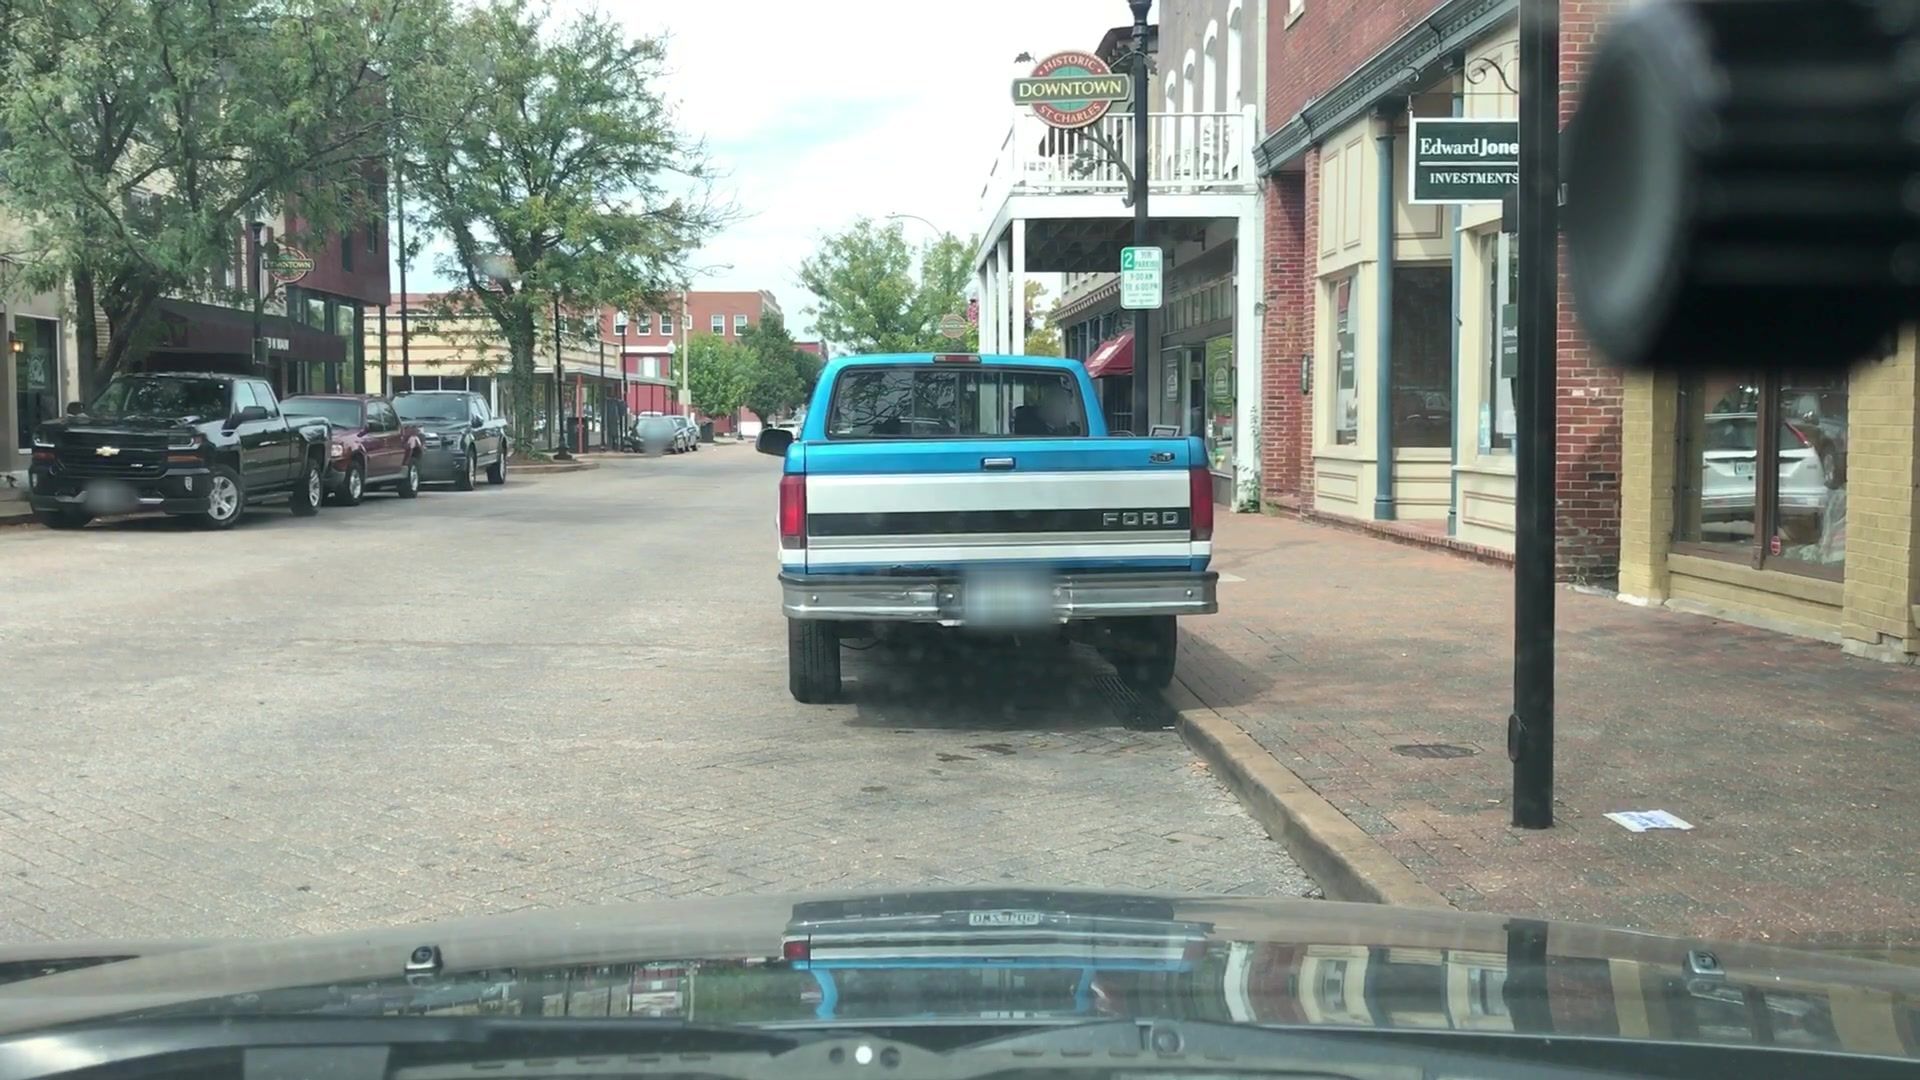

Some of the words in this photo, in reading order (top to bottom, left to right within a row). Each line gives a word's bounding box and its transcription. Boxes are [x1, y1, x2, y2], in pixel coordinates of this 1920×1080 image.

[1043, 55, 1098, 72] HISTORIC
[1019, 80, 1122, 97] DOWNTOWN
[1053, 102, 1101, 123] CHARLES
[1420, 137, 1519, 157] EdwardJone
[1429, 172, 1519, 184] INVESTMENTS
[1124, 252, 1133, 268] 2
[1102, 511, 1179, 526] FORD
